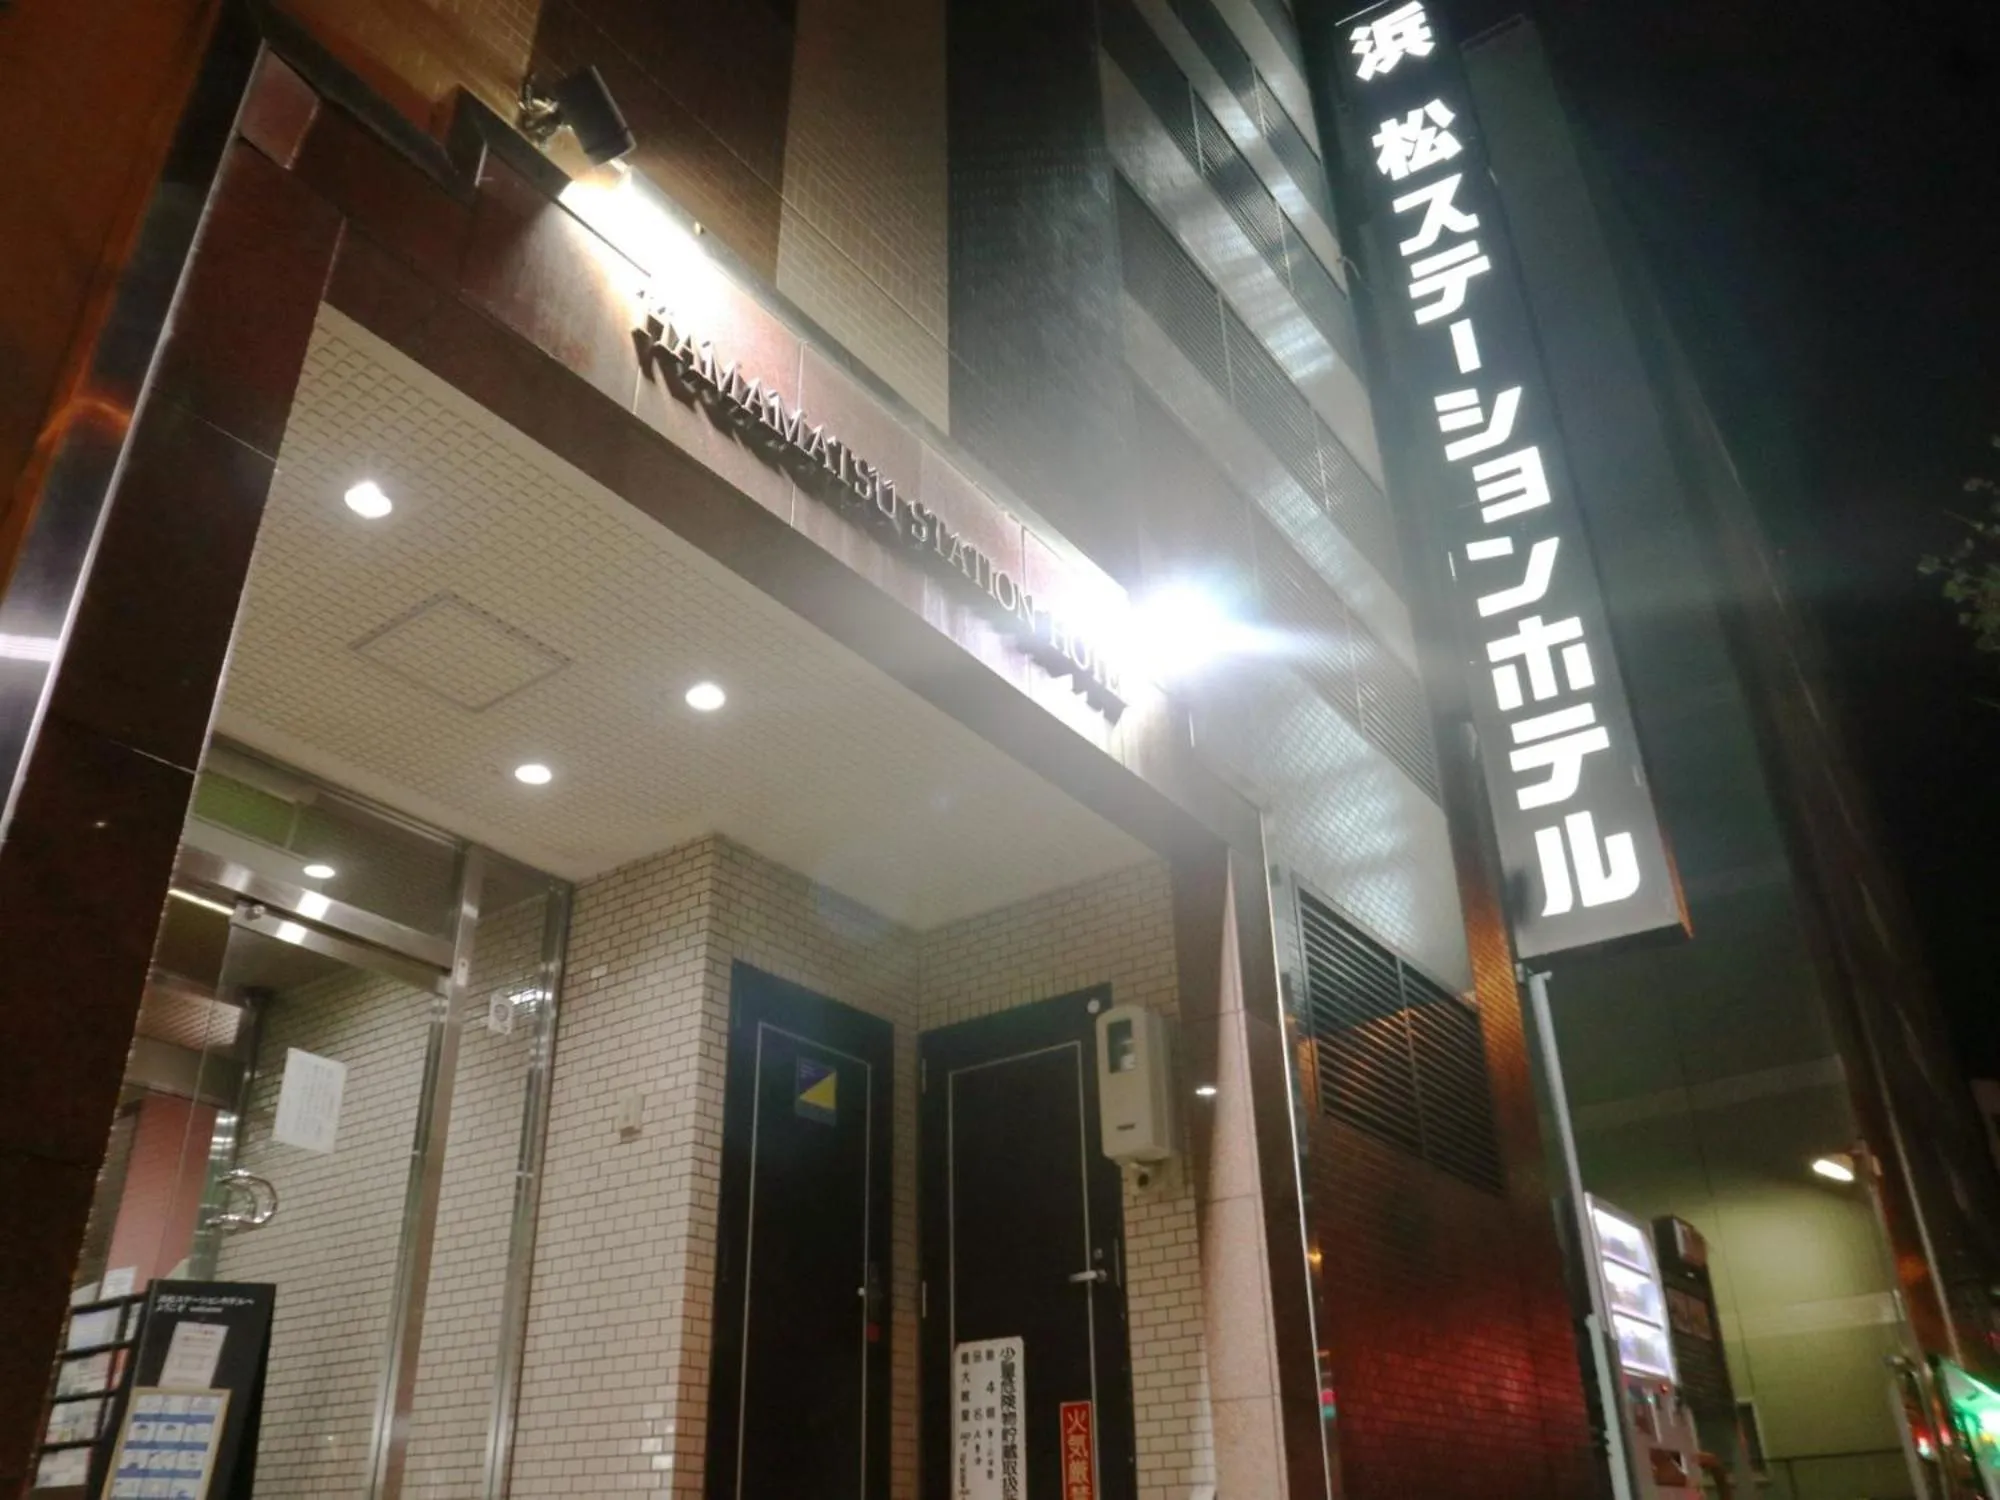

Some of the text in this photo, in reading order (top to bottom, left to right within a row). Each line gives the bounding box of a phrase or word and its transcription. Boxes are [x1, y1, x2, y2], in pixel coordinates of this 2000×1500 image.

[909, 500, 1037, 633] STATION
[1047, 608, 1128, 703] HOT
[1350, 0, 1641, 917] 浜松ステーションホテル
